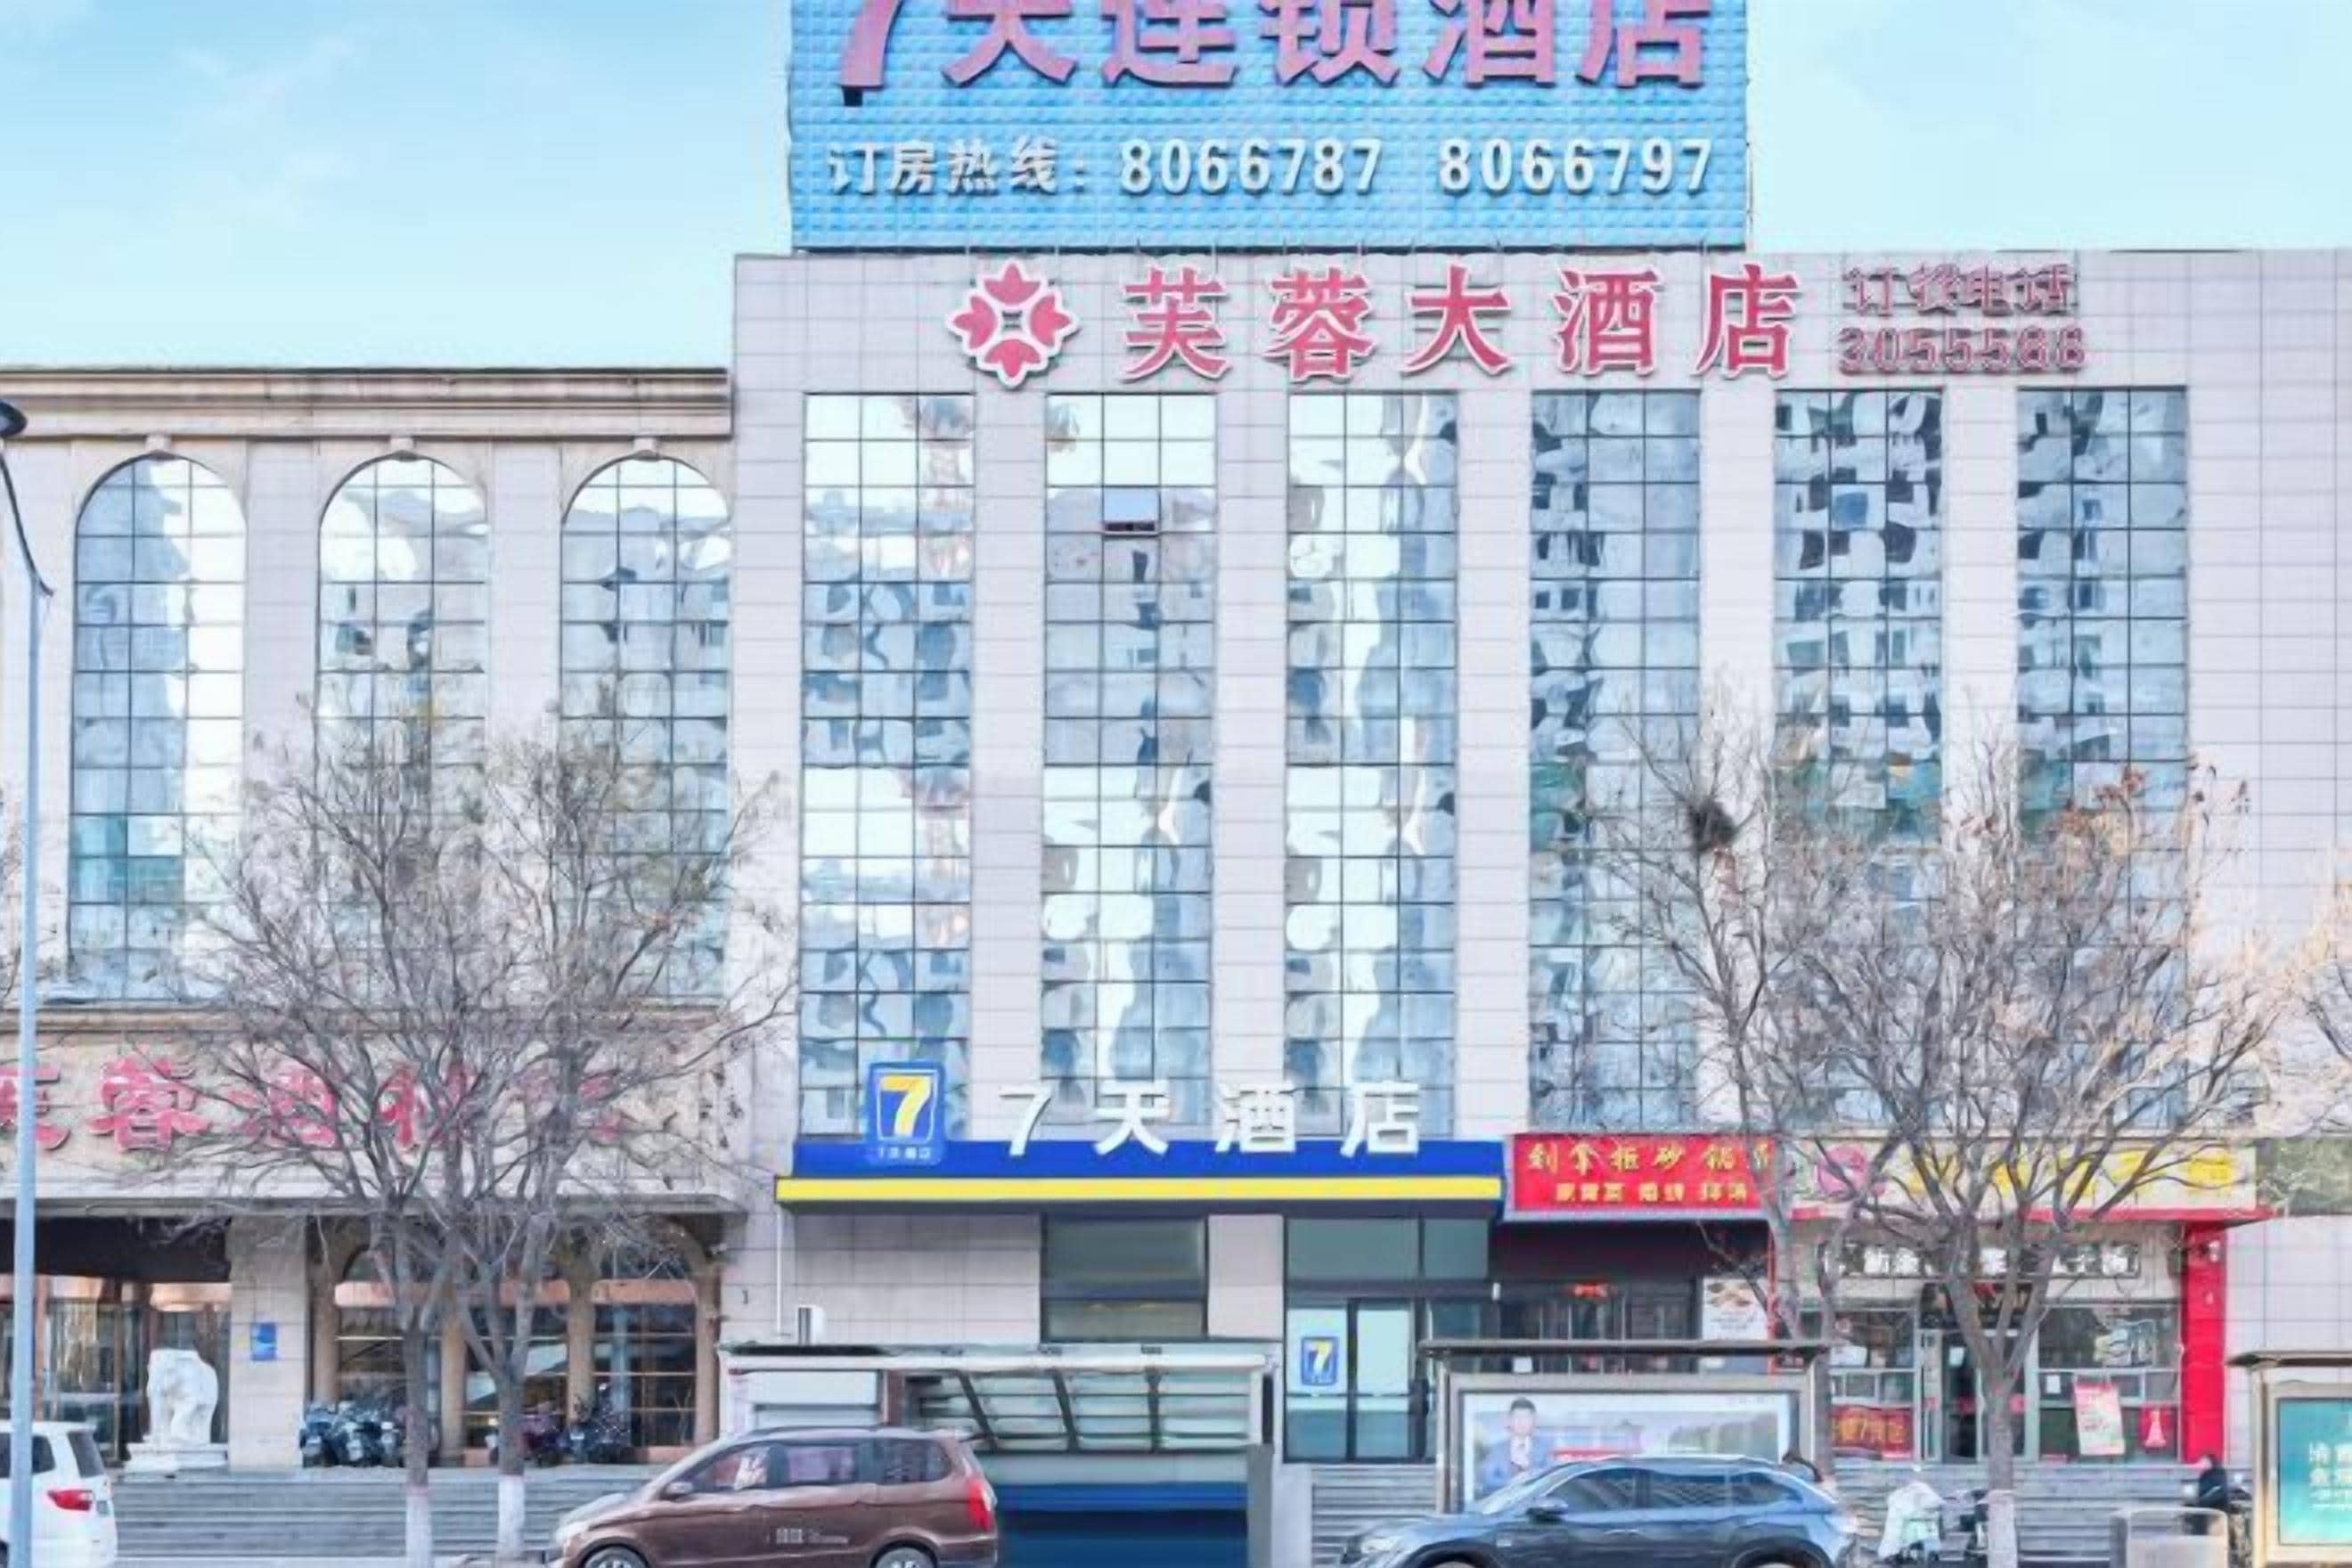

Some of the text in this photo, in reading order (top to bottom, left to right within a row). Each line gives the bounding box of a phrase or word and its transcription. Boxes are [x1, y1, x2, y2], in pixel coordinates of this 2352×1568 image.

[1119, 136, 1382, 195] 8066787
[1437, 136, 1714, 195] 8066797
[1121, 261, 1801, 382] 芙蓉大酒店
[879, 1074, 932, 1138] 7
[998, 1080, 1420, 1157] 7天酒店
